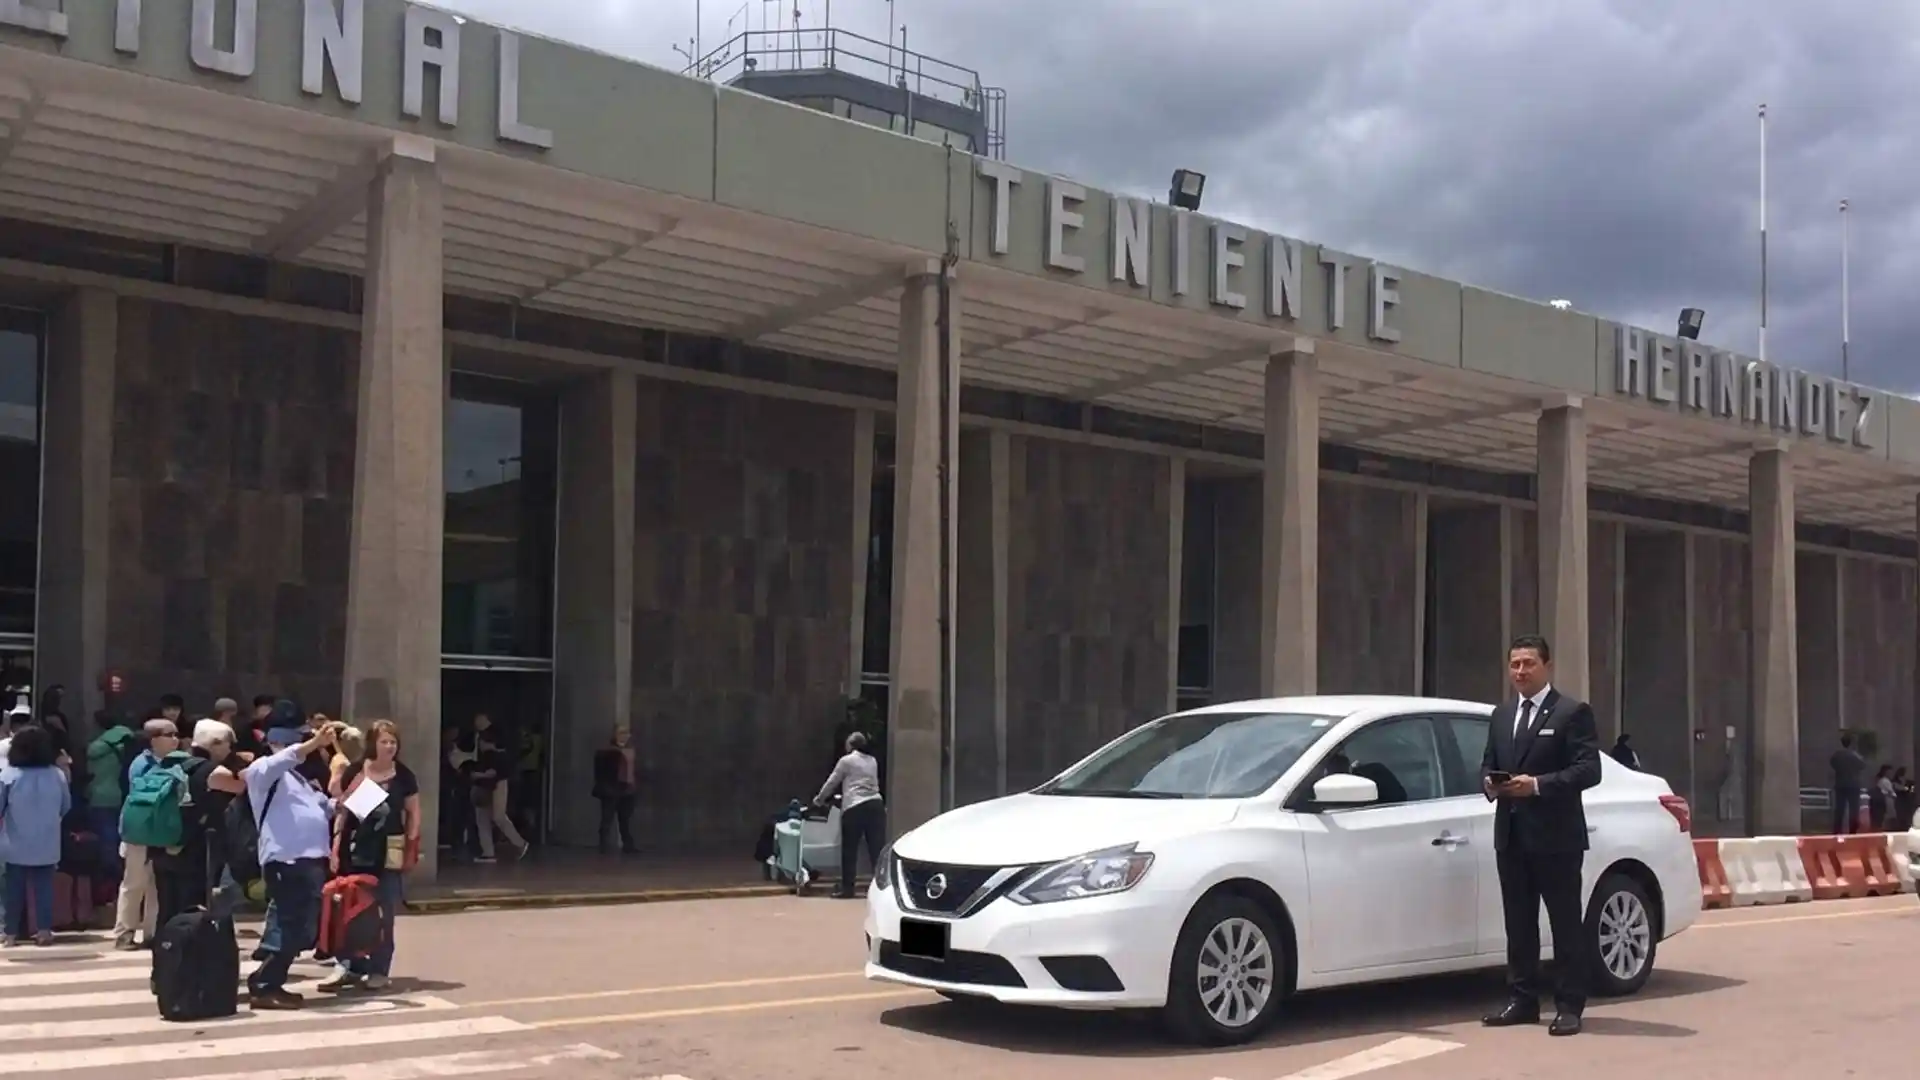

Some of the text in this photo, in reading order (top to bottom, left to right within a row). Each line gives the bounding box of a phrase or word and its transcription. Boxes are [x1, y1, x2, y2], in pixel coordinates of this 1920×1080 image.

[0, 0, 1873, 449] ONAL TENIENTE HERNANDEZ
